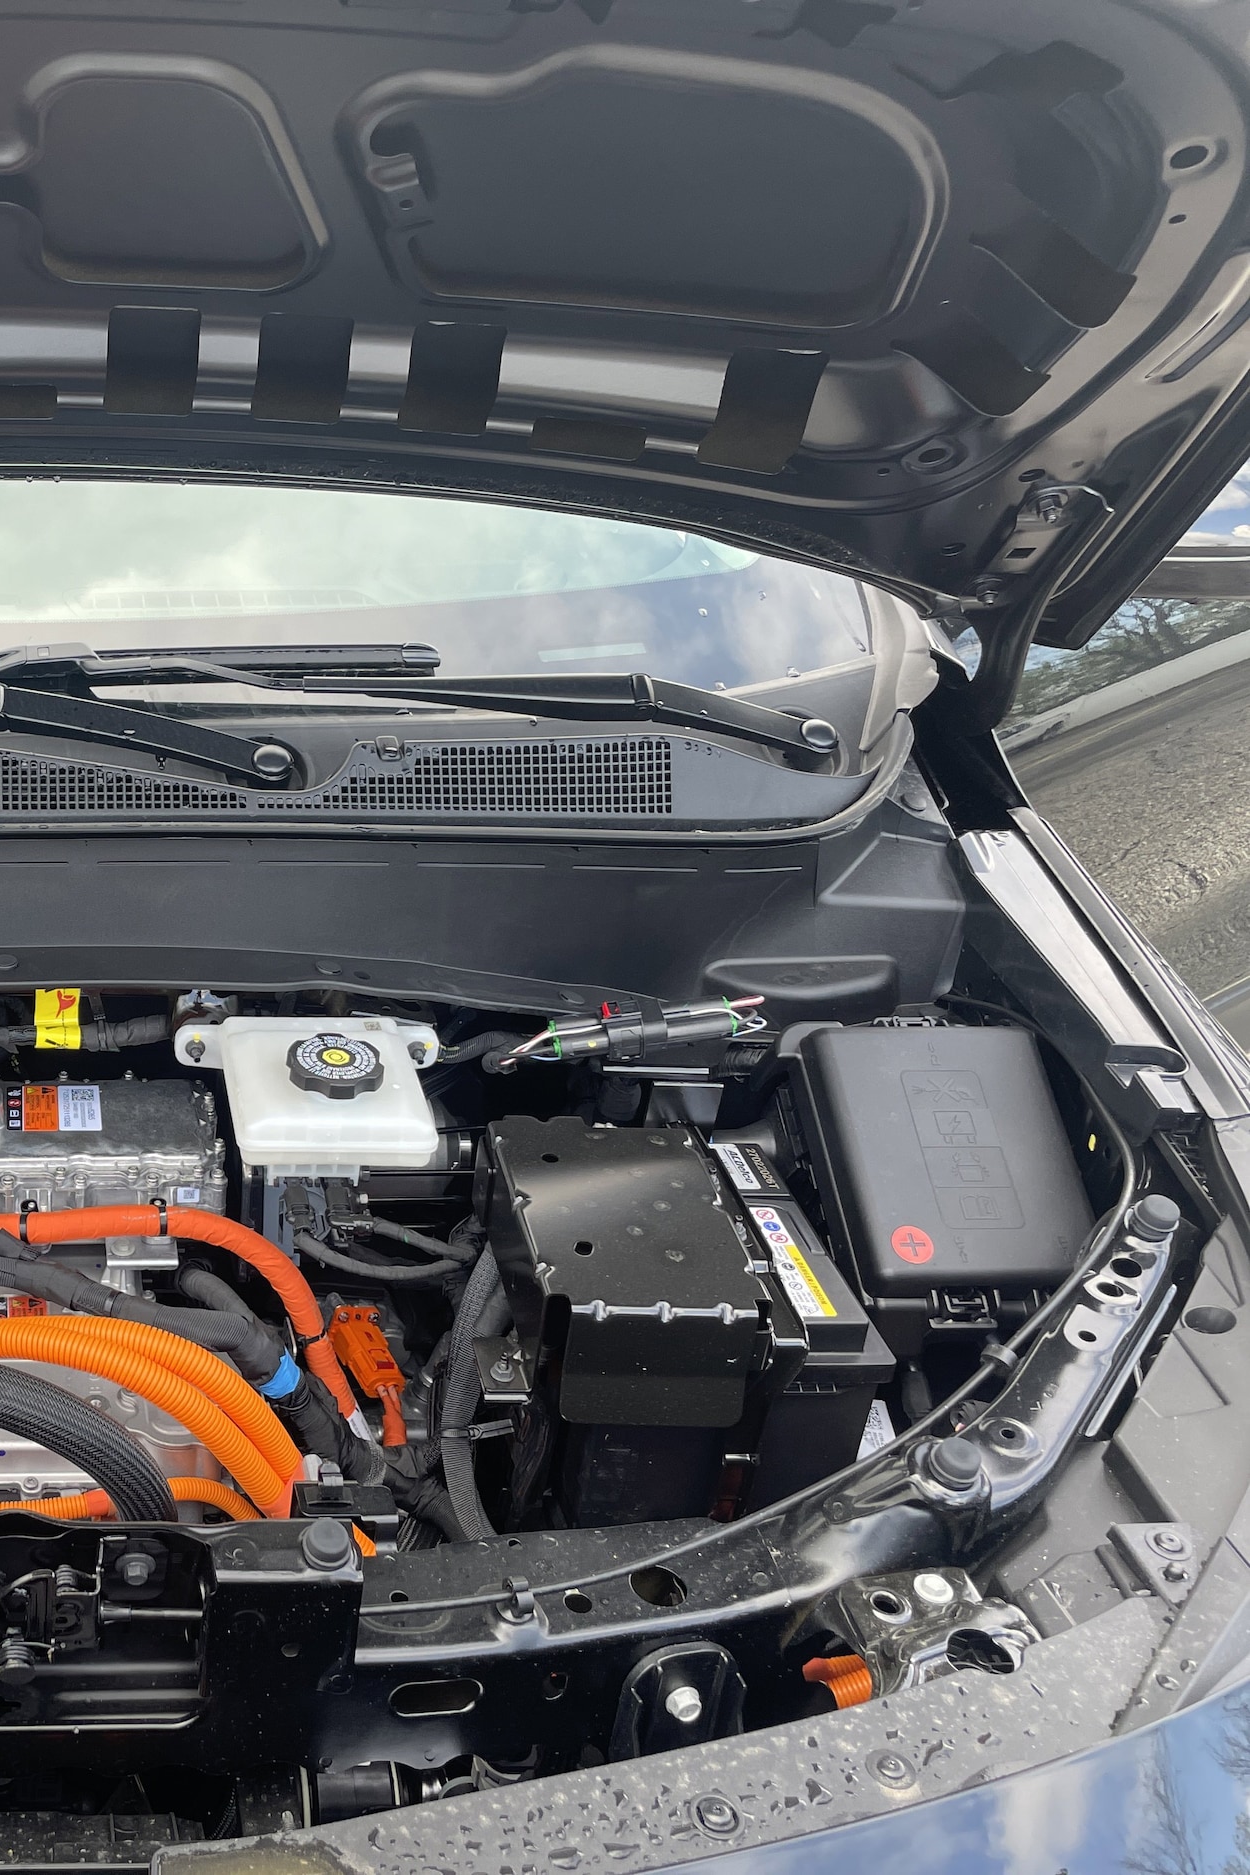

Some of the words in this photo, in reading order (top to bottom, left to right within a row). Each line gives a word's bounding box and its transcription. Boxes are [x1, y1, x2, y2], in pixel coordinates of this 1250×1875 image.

[727, 1150, 754, 1183] ACDelco
[745, 1148, 780, 1189] 27022026T
[796, 1262, 813, 1282] DANGER
[810, 1285, 827, 1305] POISON
